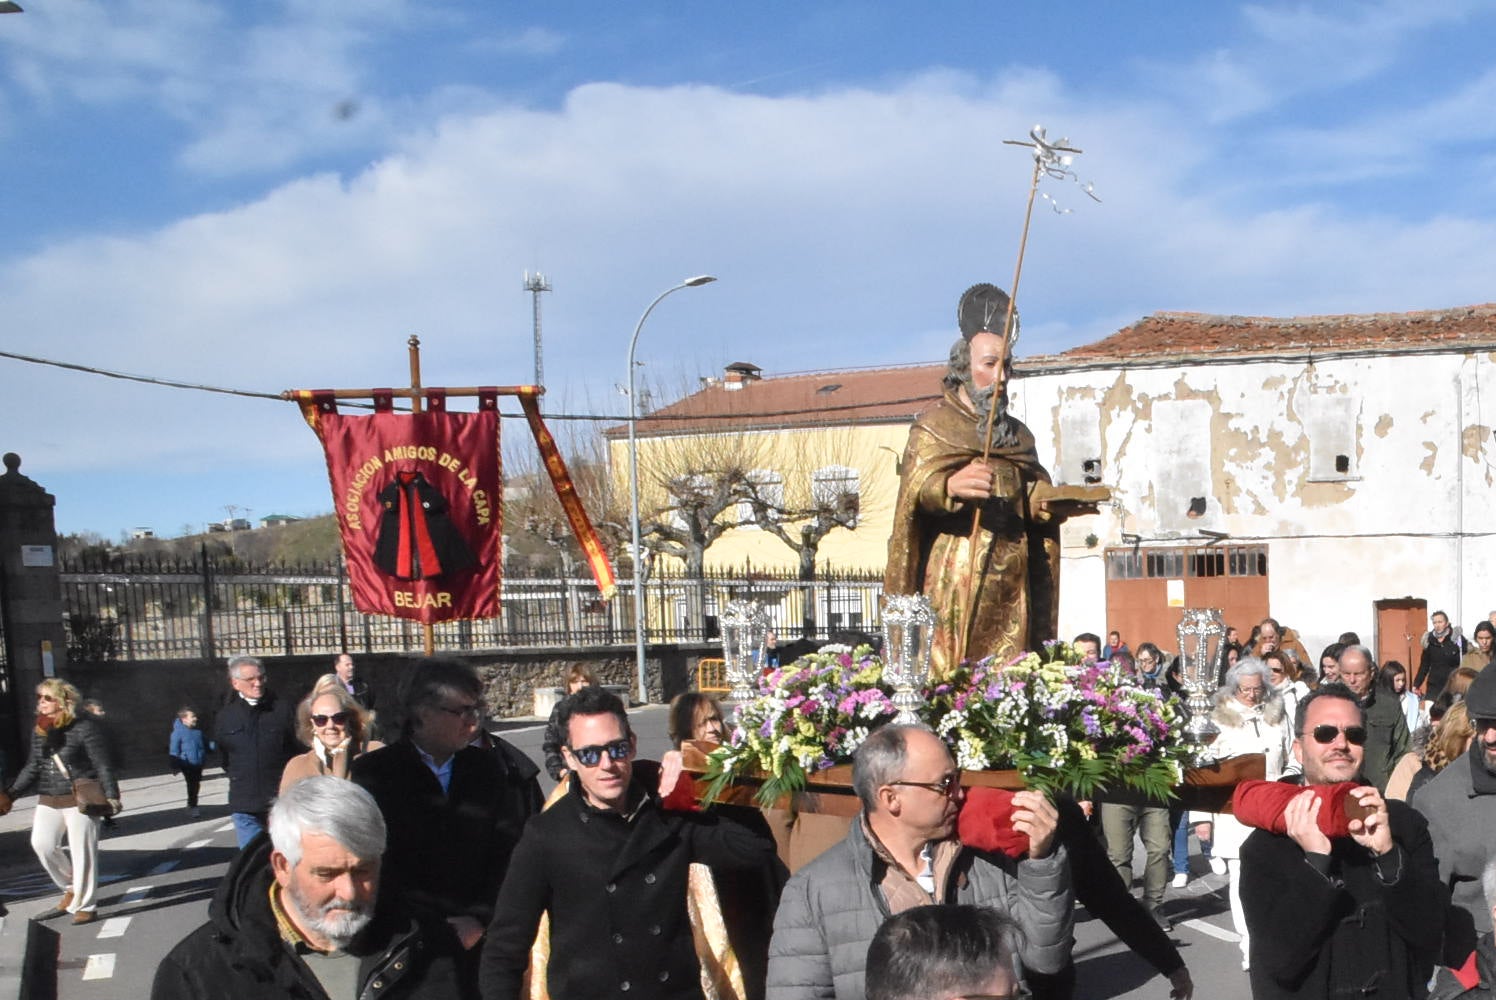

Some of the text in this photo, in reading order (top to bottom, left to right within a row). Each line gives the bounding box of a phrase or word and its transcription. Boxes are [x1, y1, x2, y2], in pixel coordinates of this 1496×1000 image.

[346, 446, 490, 530] ASOCIACION AMIGOS DE LA CAPA
[394, 590, 452, 608] BEJAR
